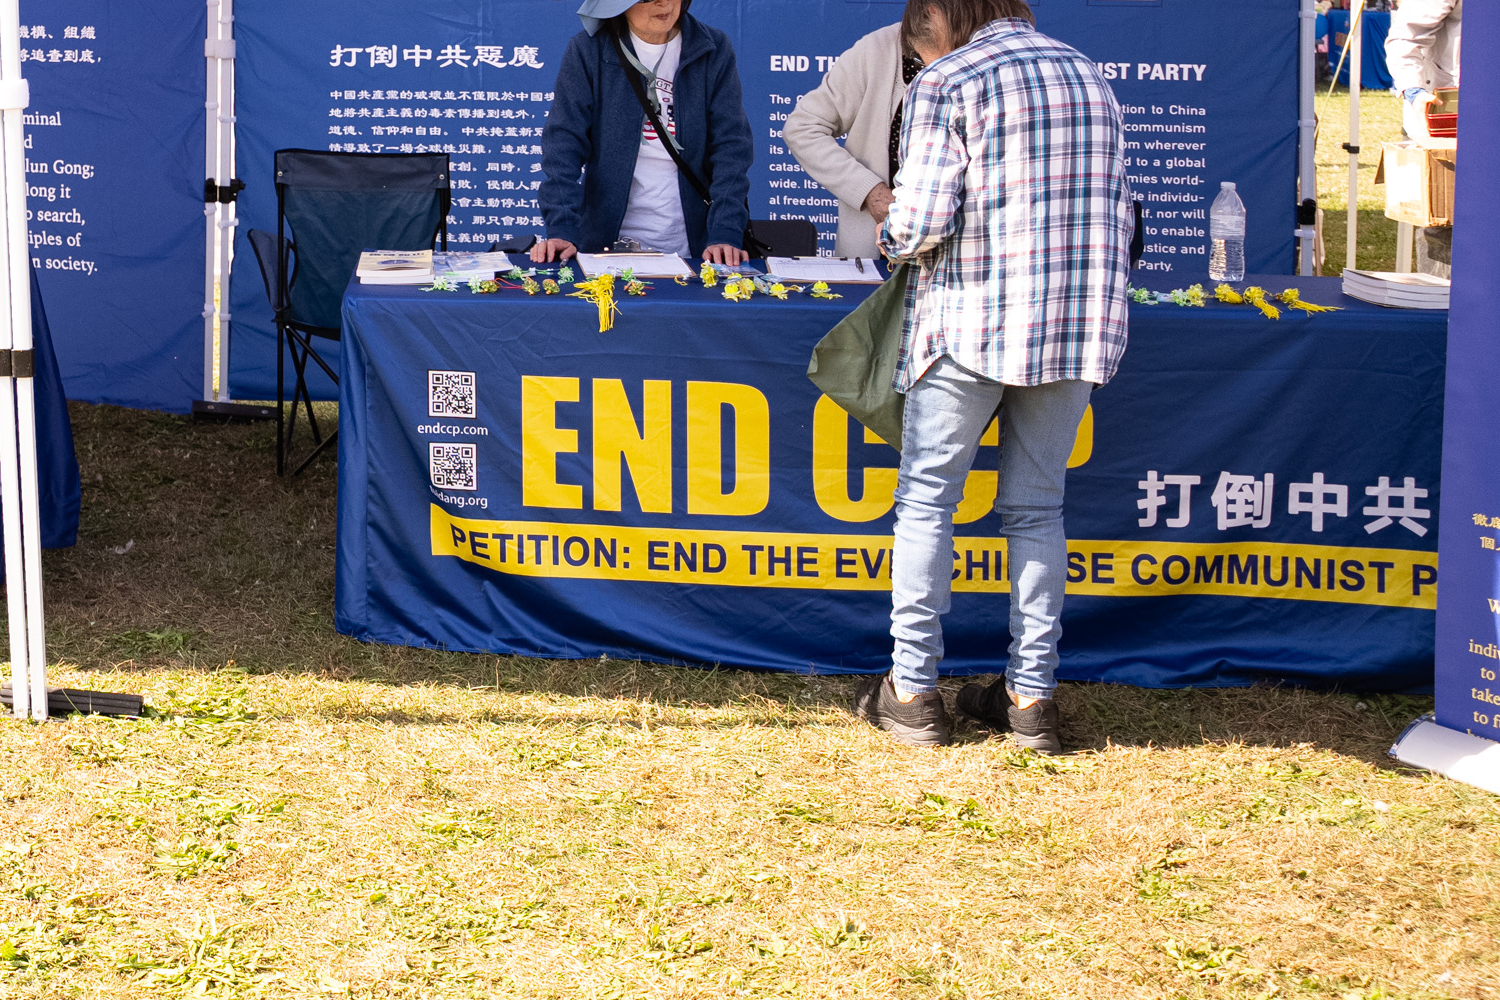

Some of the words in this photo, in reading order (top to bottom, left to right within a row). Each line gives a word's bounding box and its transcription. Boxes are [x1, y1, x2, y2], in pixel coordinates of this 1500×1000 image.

[329, 44, 544, 69] 打倒中共惡魔
[770, 55, 809, 72] END
[815, 56, 840, 72] TH
[1137, 63, 1206, 81] PARTY
[769, 94, 791, 105] The
[1151, 105, 1163, 115] to
[1169, 105, 1206, 116] China
[23, 112, 61, 126] minal
[1124, 123, 1205, 133] communism
[1144, 140, 1206, 151] wherever
[769, 145, 783, 155] its
[1136, 157, 1148, 167] to
[1153, 159, 1160, 167] a
[1165, 157, 1205, 169] global
[53, 160, 94, 179] Gong;
[1162, 174, 1204, 185] world-
[26, 182, 56, 202] long
[60, 184, 71, 199] it
[769, 179, 800, 189] wide.
[804, 179, 818, 189] Its
[1148, 192, 1204, 202] individu-
[37, 208, 86, 226] search,
[769, 196, 780, 205] al
[783, 196, 839, 207] freedoms
[1156, 210, 1178, 219] nor
[1181, 208, 1205, 219] will
[769, 212, 777, 220] it
[1145, 226, 1158, 235] to
[1162, 226, 1205, 237] enable
[67, 232, 82, 247] of
[1180, 245, 1205, 255] and
[46, 256, 98, 275] society.
[1138, 260, 1173, 272] Party.
[417, 423, 489, 436] endccp.com
[522, 375, 770, 516] END
[1138, 470, 1431, 538] 打倒中共
[449, 522, 631, 570] PETITION:
[647, 540, 727, 575] END
[742, 545, 818, 579] THE
[835, 548, 894, 580] EVI
[951, 550, 1115, 584] HISE
[1131, 553, 1395, 596] COMMUNIST
[1480, 666, 1496, 681] to
[1473, 710, 1489, 725] to
